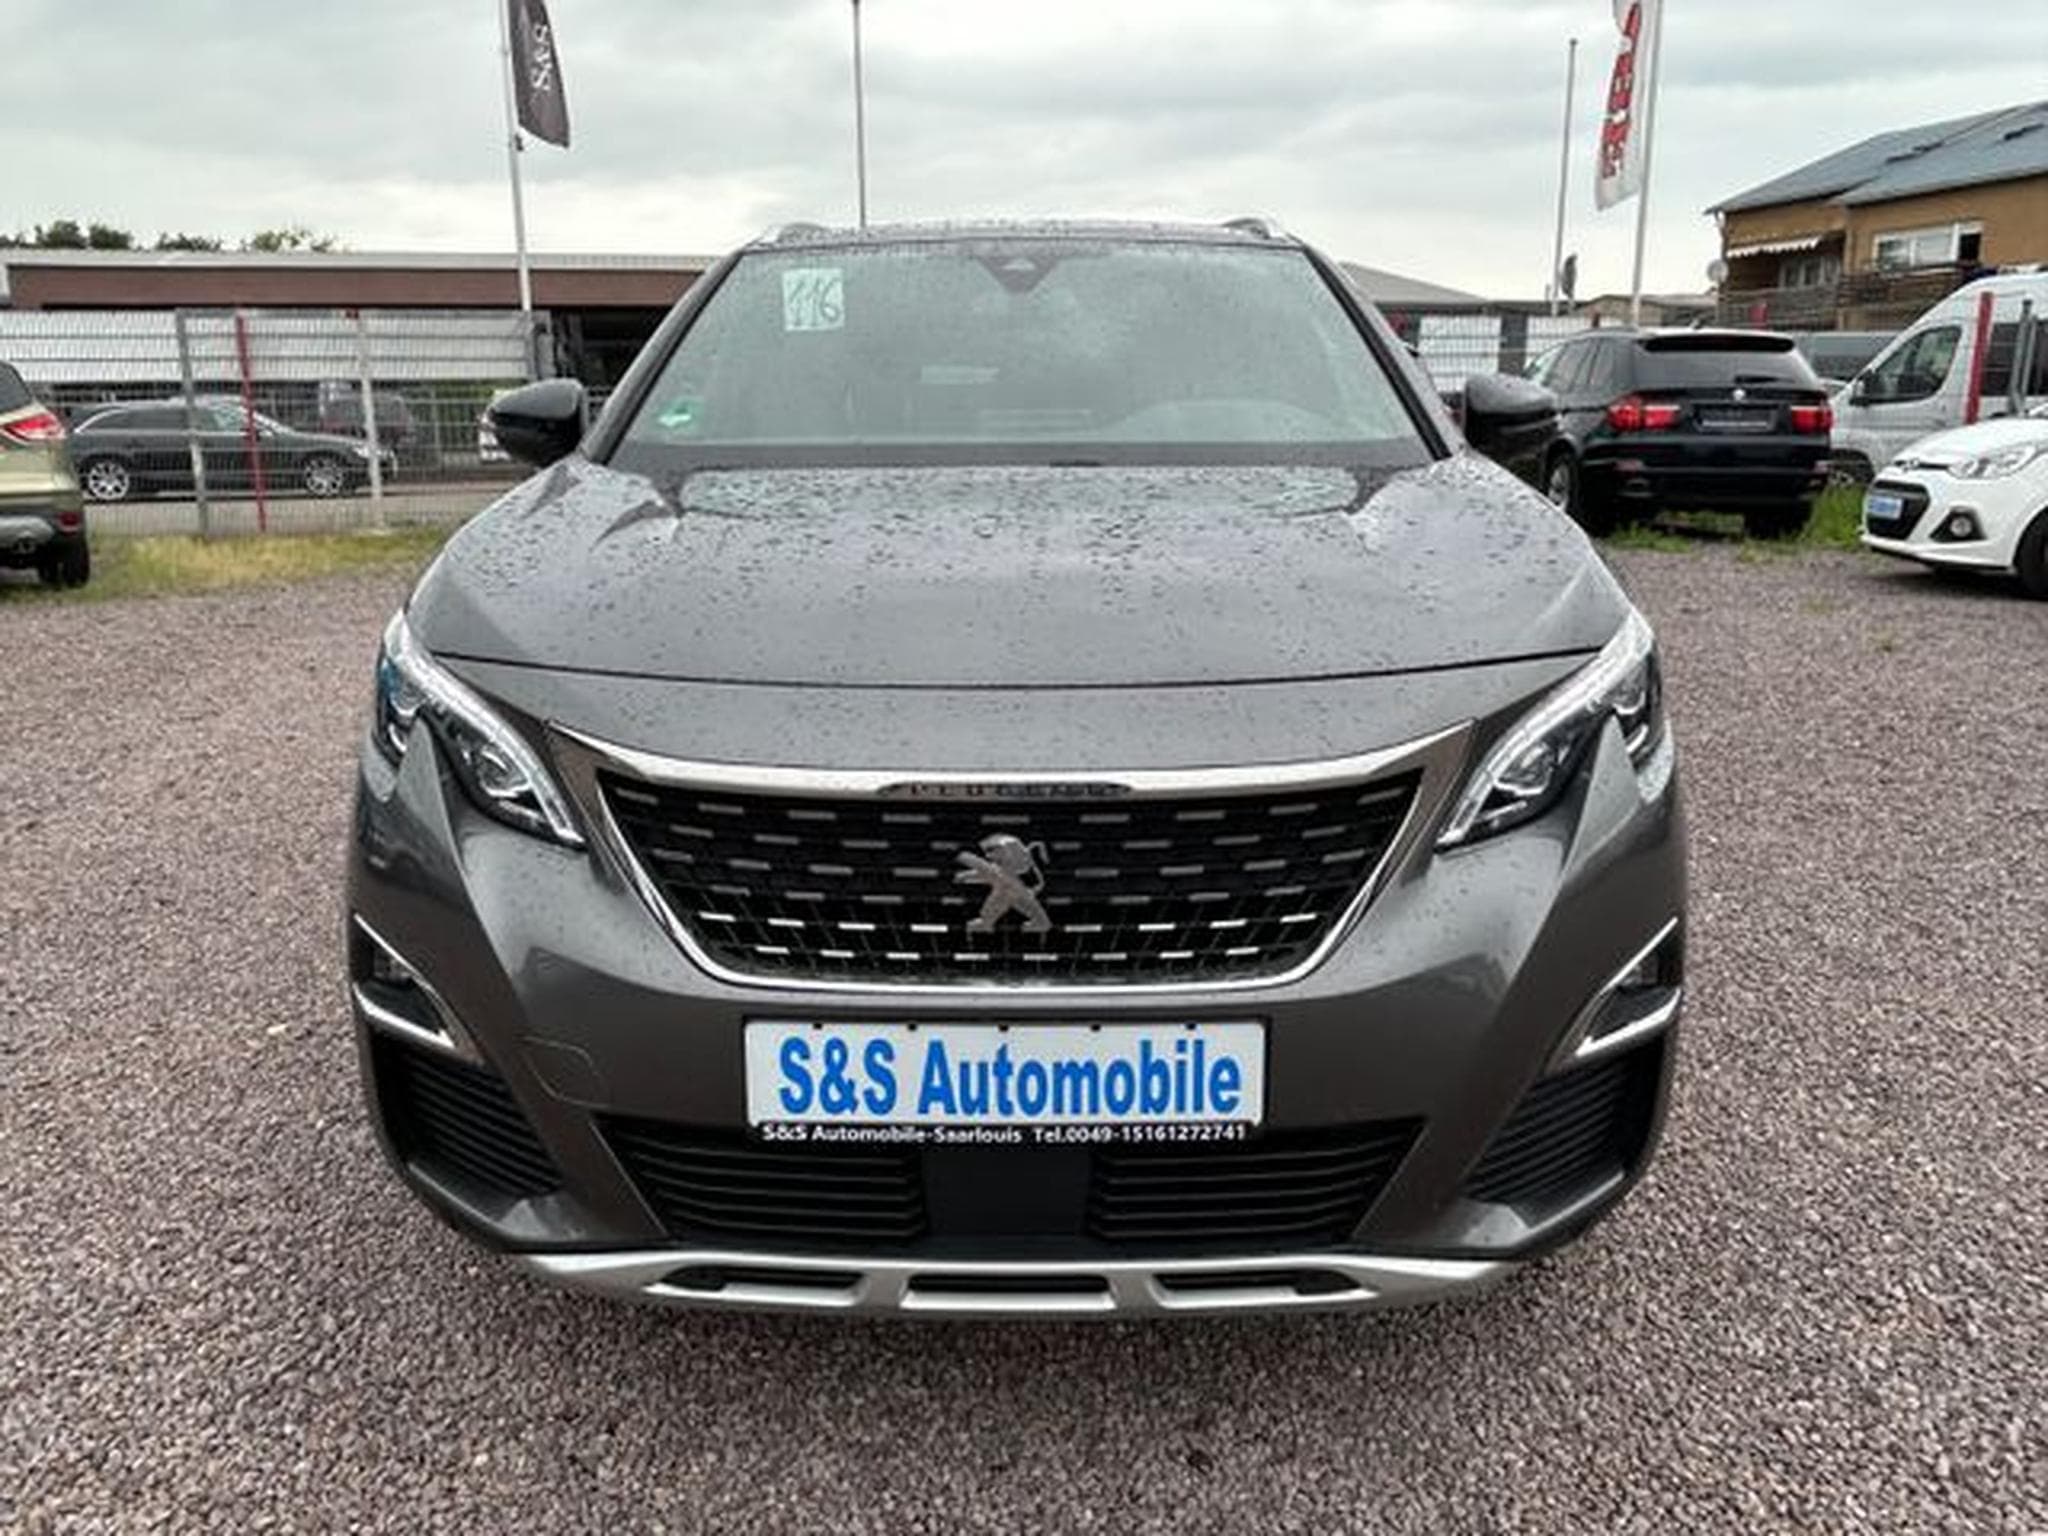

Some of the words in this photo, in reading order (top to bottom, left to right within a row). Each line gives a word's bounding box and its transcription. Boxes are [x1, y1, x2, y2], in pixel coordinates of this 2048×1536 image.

[778, 1037, 898, 1116] S&S
[918, 1040, 1241, 1116] Automobile
[762, 1124, 808, 1141] S&S
[812, 1124, 1022, 1143] Automobile-Saarlouis
